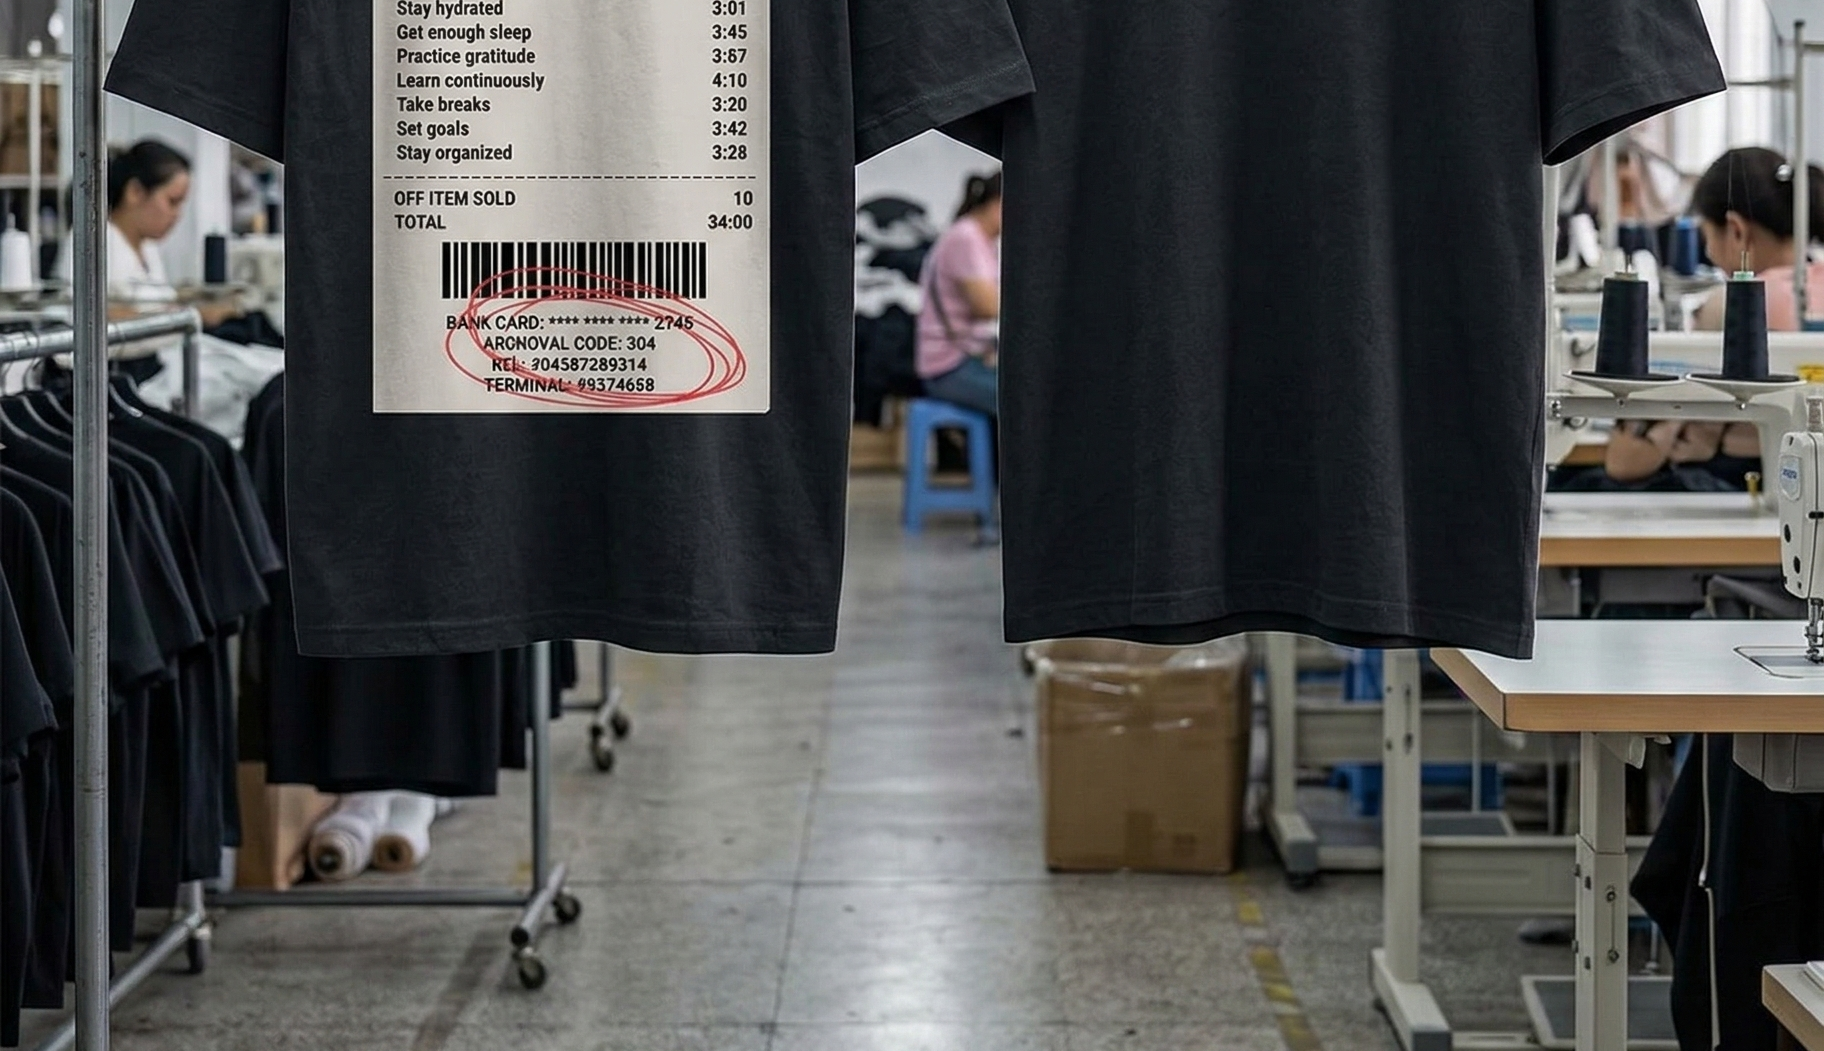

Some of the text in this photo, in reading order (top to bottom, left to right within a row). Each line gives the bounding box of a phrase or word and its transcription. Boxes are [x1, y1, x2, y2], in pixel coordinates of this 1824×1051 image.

[396, 0, 746, 20] Stay hydrated 3:01
[396, 23, 748, 44] Get enough sleep 3:45
[397, 47, 461, 64] Practice
[465, 47, 536, 68] gratitude
[397, 71, 748, 92] Learn continuously 4:10
[396, 95, 748, 112] Take breaks 3:20
[396, 119, 748, 140] Set goals 3:42
[396, 144, 748, 164] Stay organized 3:28
[394, 190, 753, 206] OFF ITEM SOLD 10
[394, 214, 753, 230] TOTAL 34:00
[446, 315, 492, 331] BANK
[495, 315, 545, 331] CARD:
[573, 335, 623, 351] CODE:
[626, 335, 657, 351] 304
[484, 377, 572, 393] TERMINAL:
